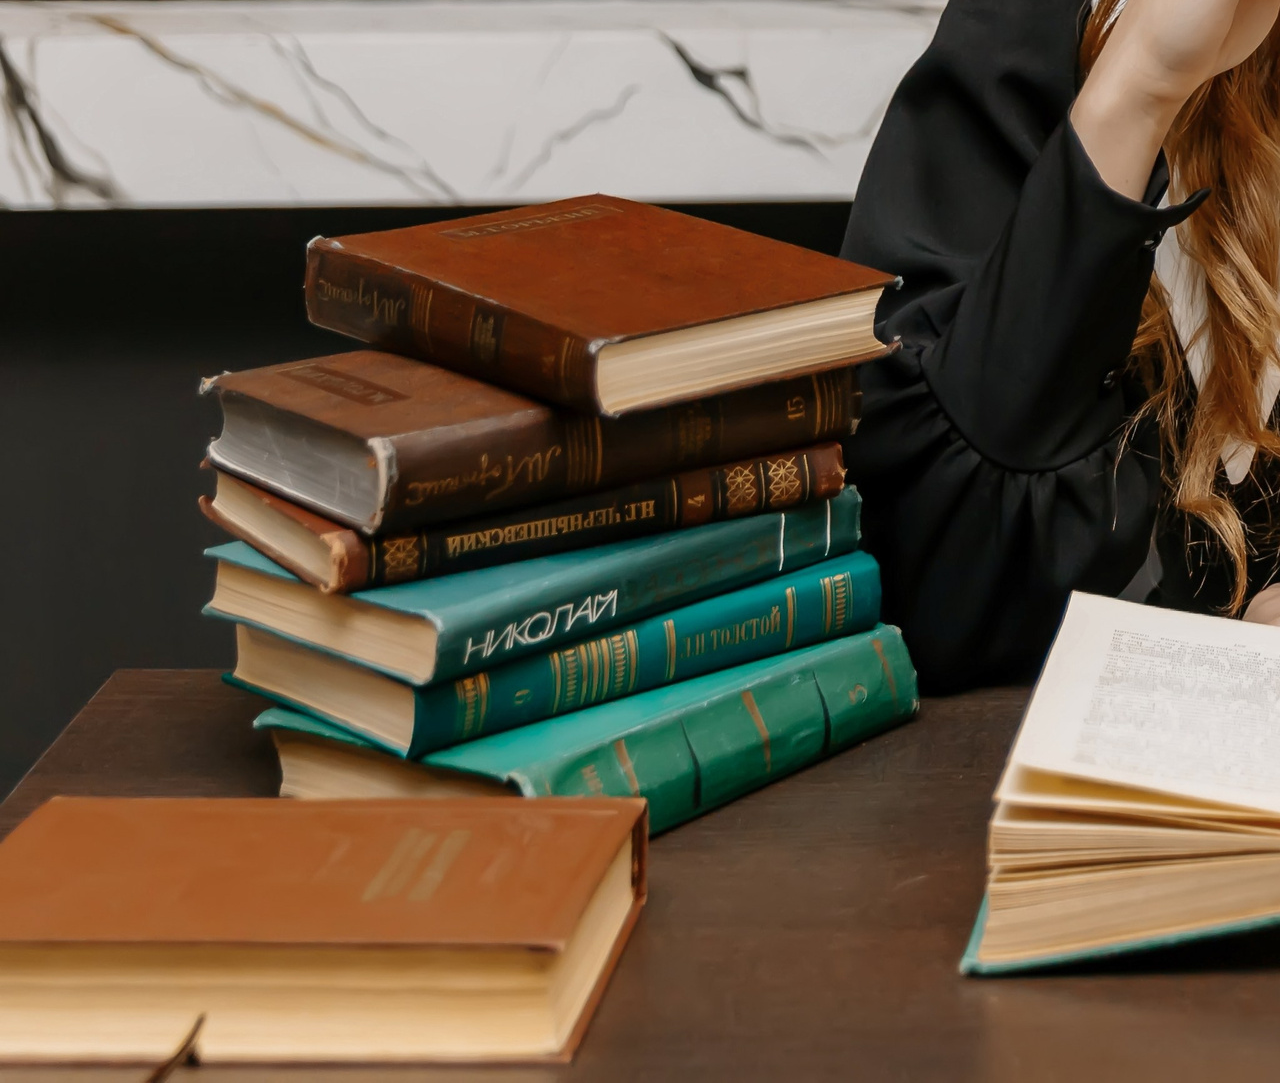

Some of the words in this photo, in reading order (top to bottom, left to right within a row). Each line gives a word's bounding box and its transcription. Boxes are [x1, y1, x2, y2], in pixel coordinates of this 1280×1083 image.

[787, 396, 806, 420] 15
[687, 493, 706, 508] 4
[446, 506, 620, 558] ЧЕРНЫШЕВСКИЙ
[464, 589, 618, 665] НИКОЛАЙ
[710, 605, 781, 652] ТОЛСТОЙ
